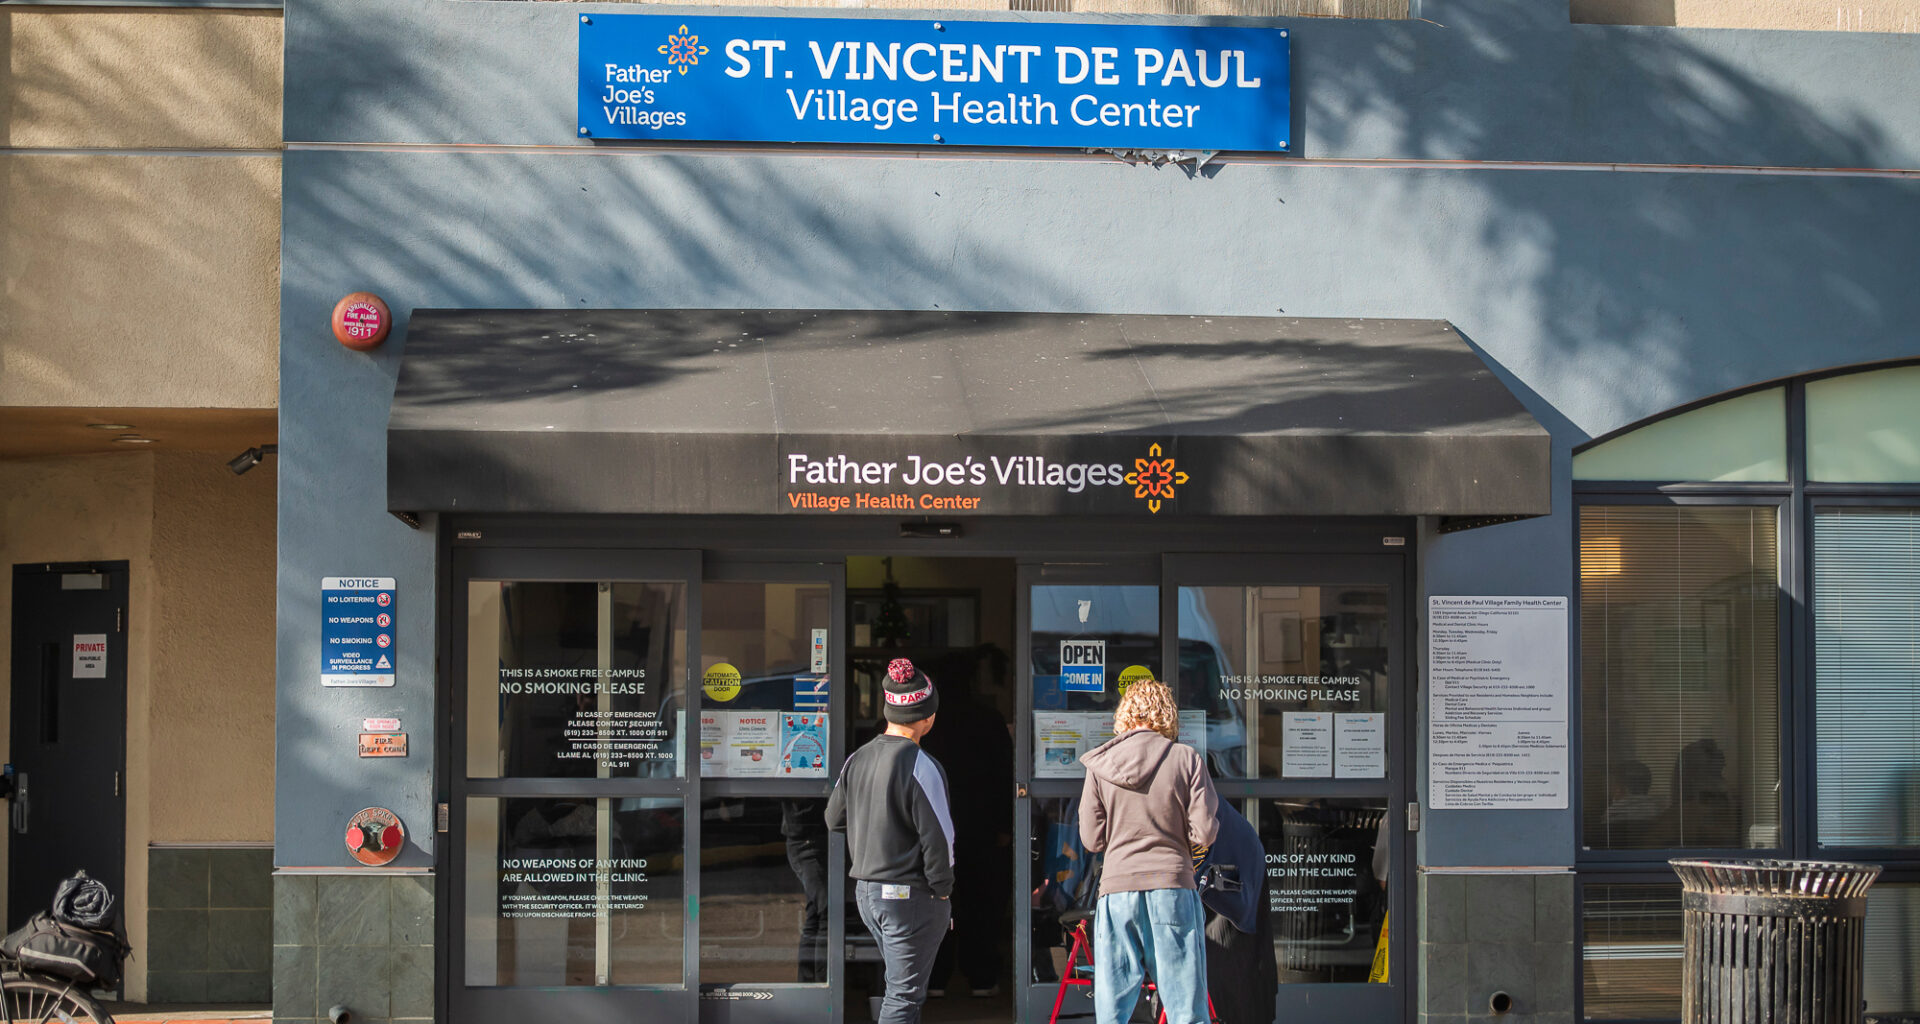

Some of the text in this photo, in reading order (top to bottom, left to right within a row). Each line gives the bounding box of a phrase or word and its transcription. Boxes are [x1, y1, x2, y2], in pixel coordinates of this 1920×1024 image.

[724, 39, 1261, 88] ST. VINCENT DE PAUL
[605, 64, 672, 83] Father
[603, 85, 654, 106] Joe's
[787, 89, 1200, 131] Village Health Center
[604, 106, 686, 128] Villages
[788, 454, 1123, 492] Father Joe's Villages
[788, 493, 980, 512] Village Health Center
[75, 644, 105, 652] PRIVATE
[1063, 646, 1102, 664] OPEN
[501, 669, 645, 678] THIS IS A SMOKE FREE CAMPUS
[1064, 673, 1101, 684] COME IN
[1322, 677, 1360, 685] CAMPUS
[500, 683, 645, 694] NO SMOKING PLEASE
[901, 690, 927, 703] PARK
[1220, 689, 1360, 701] NO SMOKING PLEASE
[503, 859, 647, 868] NO WEAPONS OF ANY KIND
[1290, 855, 1304, 863] OF
[1306, 855, 1328, 863] ANY
[1330, 854, 1356, 863] KIND
[503, 874, 648, 882] ARE ALLOWED IN THE CLINIC.
[1287, 868, 1297, 877] IN
[1300, 868, 1319, 877] THE
[1321, 868, 1356, 877] CLINIC.
